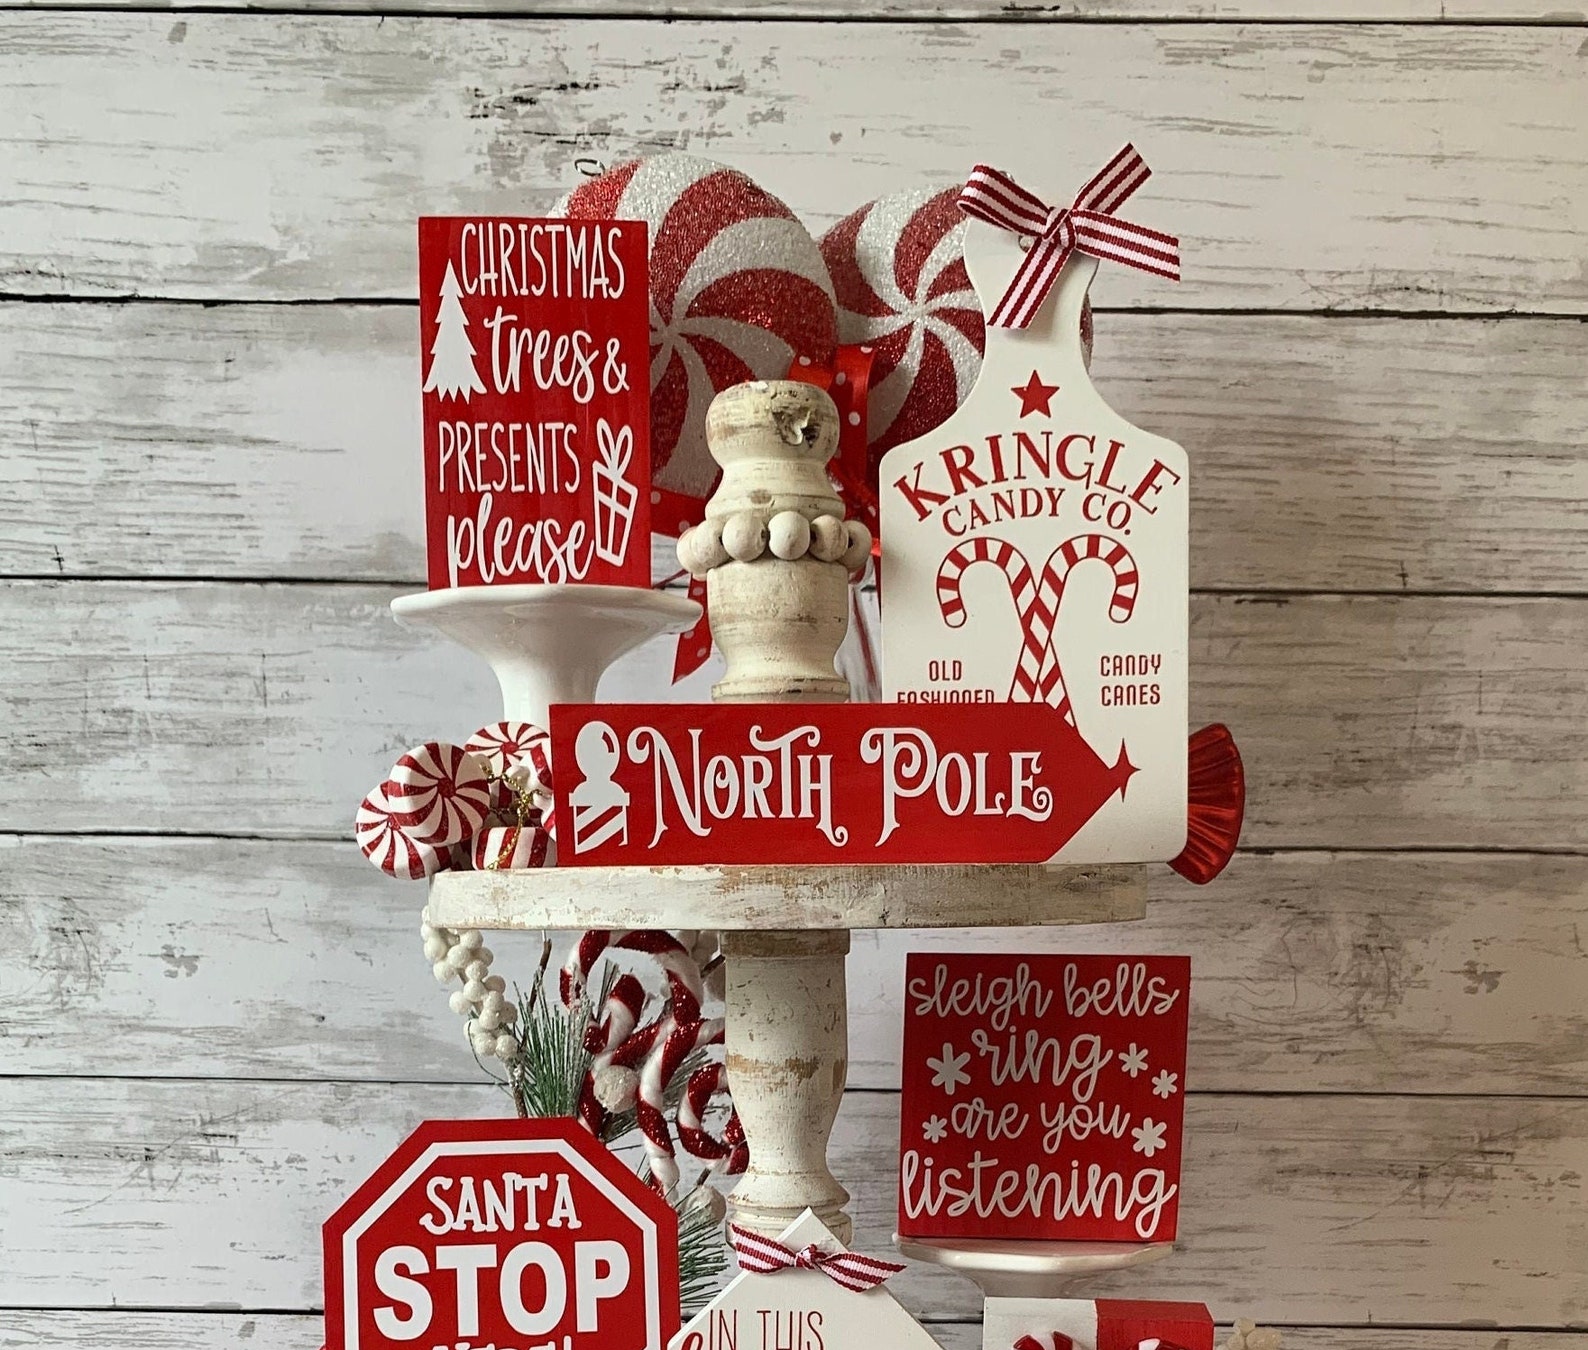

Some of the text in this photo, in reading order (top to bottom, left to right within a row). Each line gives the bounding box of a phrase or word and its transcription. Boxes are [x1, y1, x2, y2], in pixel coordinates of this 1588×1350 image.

[461, 222, 625, 299] CHRISTMAS
[484, 305, 630, 404] trees &
[439, 421, 581, 495] PRESENTS
[893, 431, 1181, 523] KRINGLE
[448, 492, 595, 588] please
[942, 487, 1132, 537] CANDY CO.
[929, 660, 962, 682] OLD
[1100, 654, 1161, 677] CANDY
[1101, 684, 1161, 707] CANES
[908, 963, 1180, 1031] sleigh bells
[971, 1025, 1114, 1103] ring
[951, 1097, 1131, 1154] are you
[419, 1172, 582, 1236] SANTA
[902, 1150, 1177, 1239] listening
[373, 1240, 631, 1341] STOP
